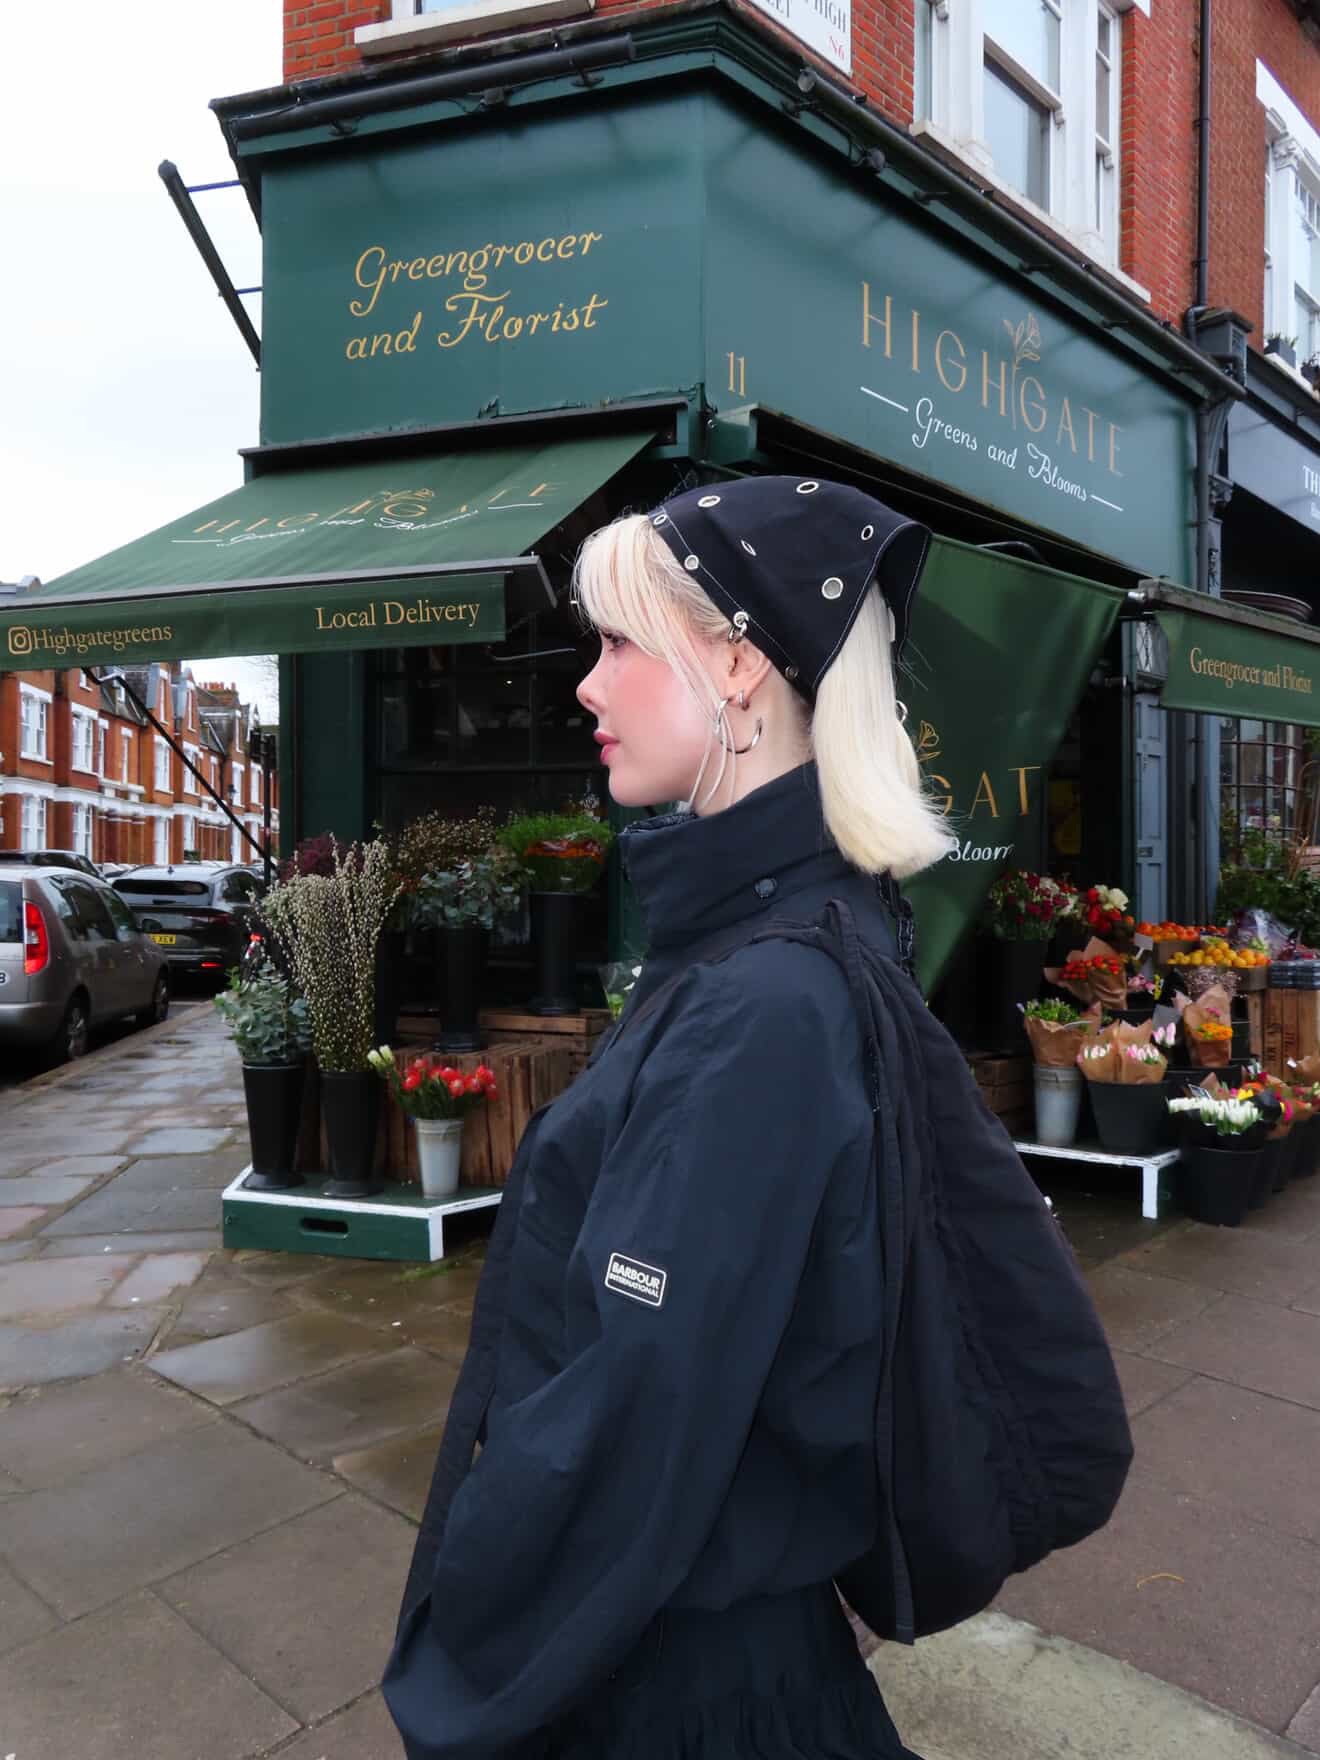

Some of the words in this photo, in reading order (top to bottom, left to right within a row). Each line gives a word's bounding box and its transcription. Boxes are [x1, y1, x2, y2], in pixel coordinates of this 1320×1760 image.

[350, 230, 603, 317] Greengrocer
[345, 311, 423, 360] and
[438, 289, 609, 349] Florist
[725, 351, 746, 397] 11
[861, 280, 1125, 477] HIGHGATE
[911, 397, 978, 449] Greens
[988, 443, 1017, 470] and
[1026, 442, 1088, 502] Blooms
[1302, 464, 1320, 497] TH
[315, 602, 378, 630] Local
[384, 599, 480, 628] Delivery
[32, 625, 173, 655] Highgategreens
[1189, 647, 1261, 689] Greengrocer
[1263, 664, 1281, 687] and
[611, 1262, 660, 1288] BARBOUR
